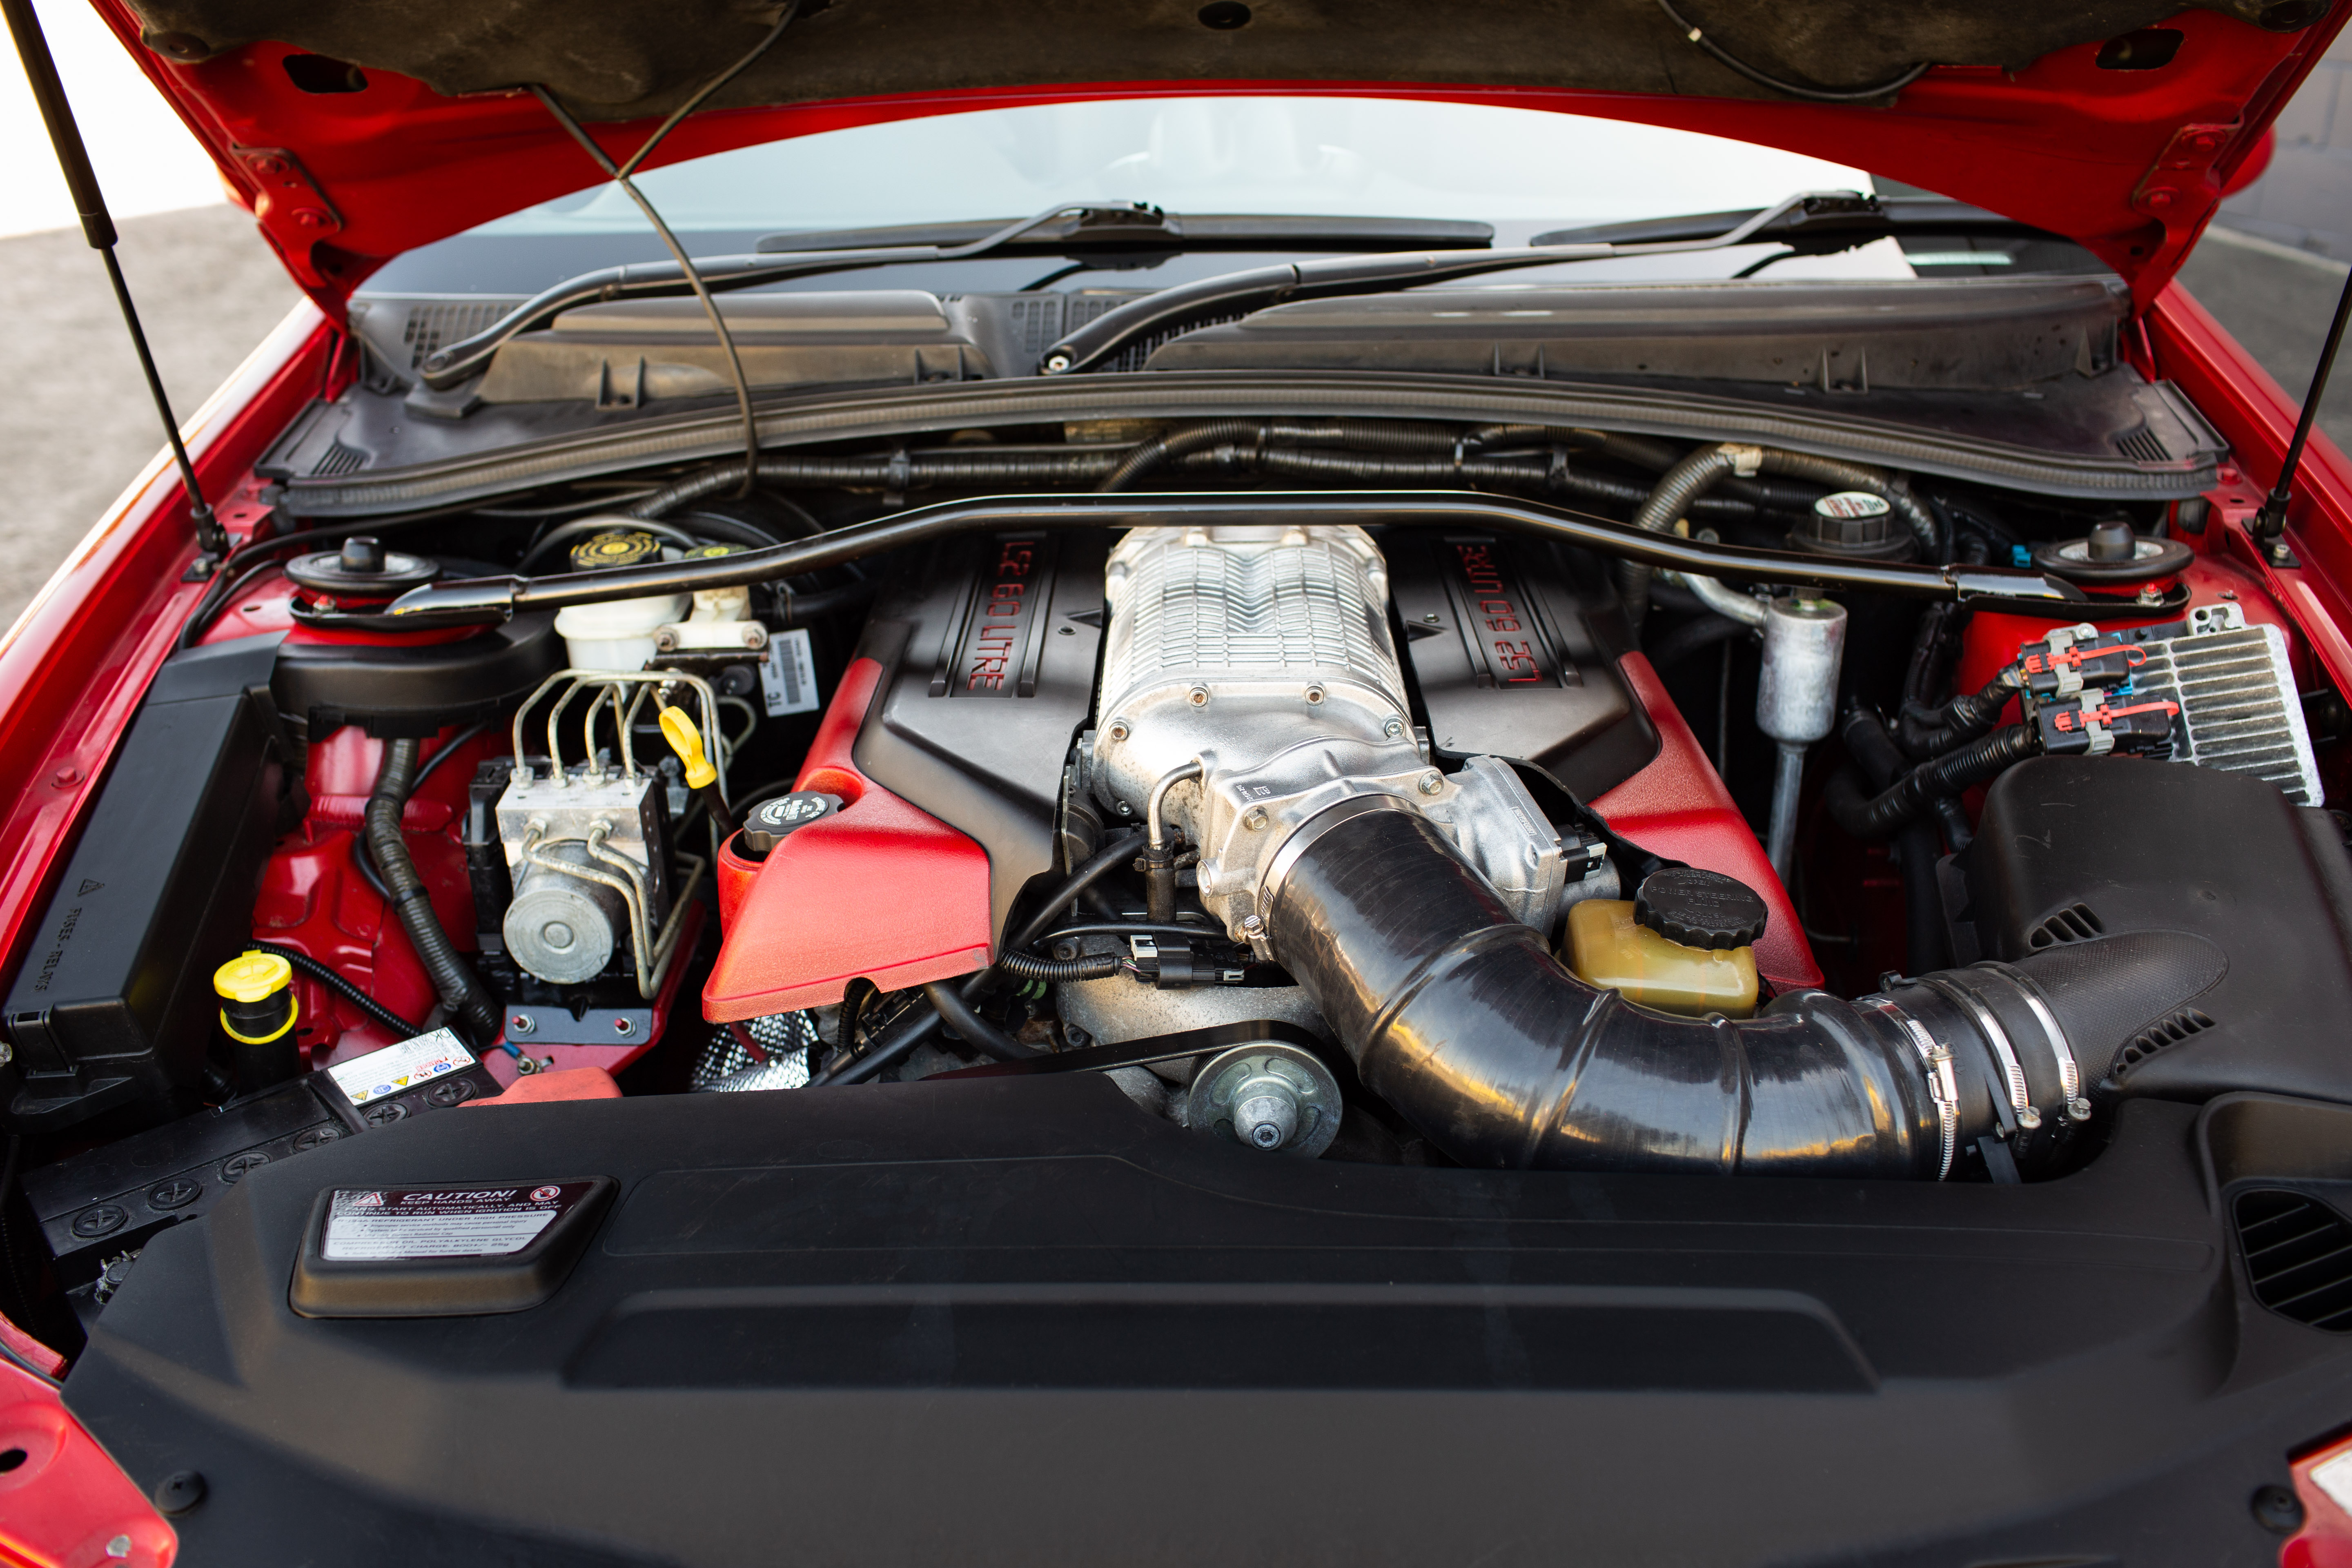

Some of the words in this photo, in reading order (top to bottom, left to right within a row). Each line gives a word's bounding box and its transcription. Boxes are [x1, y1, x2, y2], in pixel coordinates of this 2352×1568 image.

[997, 541, 1034, 577] LS2
[1457, 545, 1505, 593] LITRE
[1479, 600, 1521, 631] 6.0
[967, 625, 1016, 690] LITRE
[1495, 641, 1543, 682] LS2
[1651, 886, 1693, 896] POWER
[1696, 891, 1754, 902] STEERING
[1687, 898, 1720, 907] FLUID
[58, 907, 82, 941] FUSES
[34, 950, 63, 991] RELAYS
[403, 1190, 517, 1200] CAUTION!
